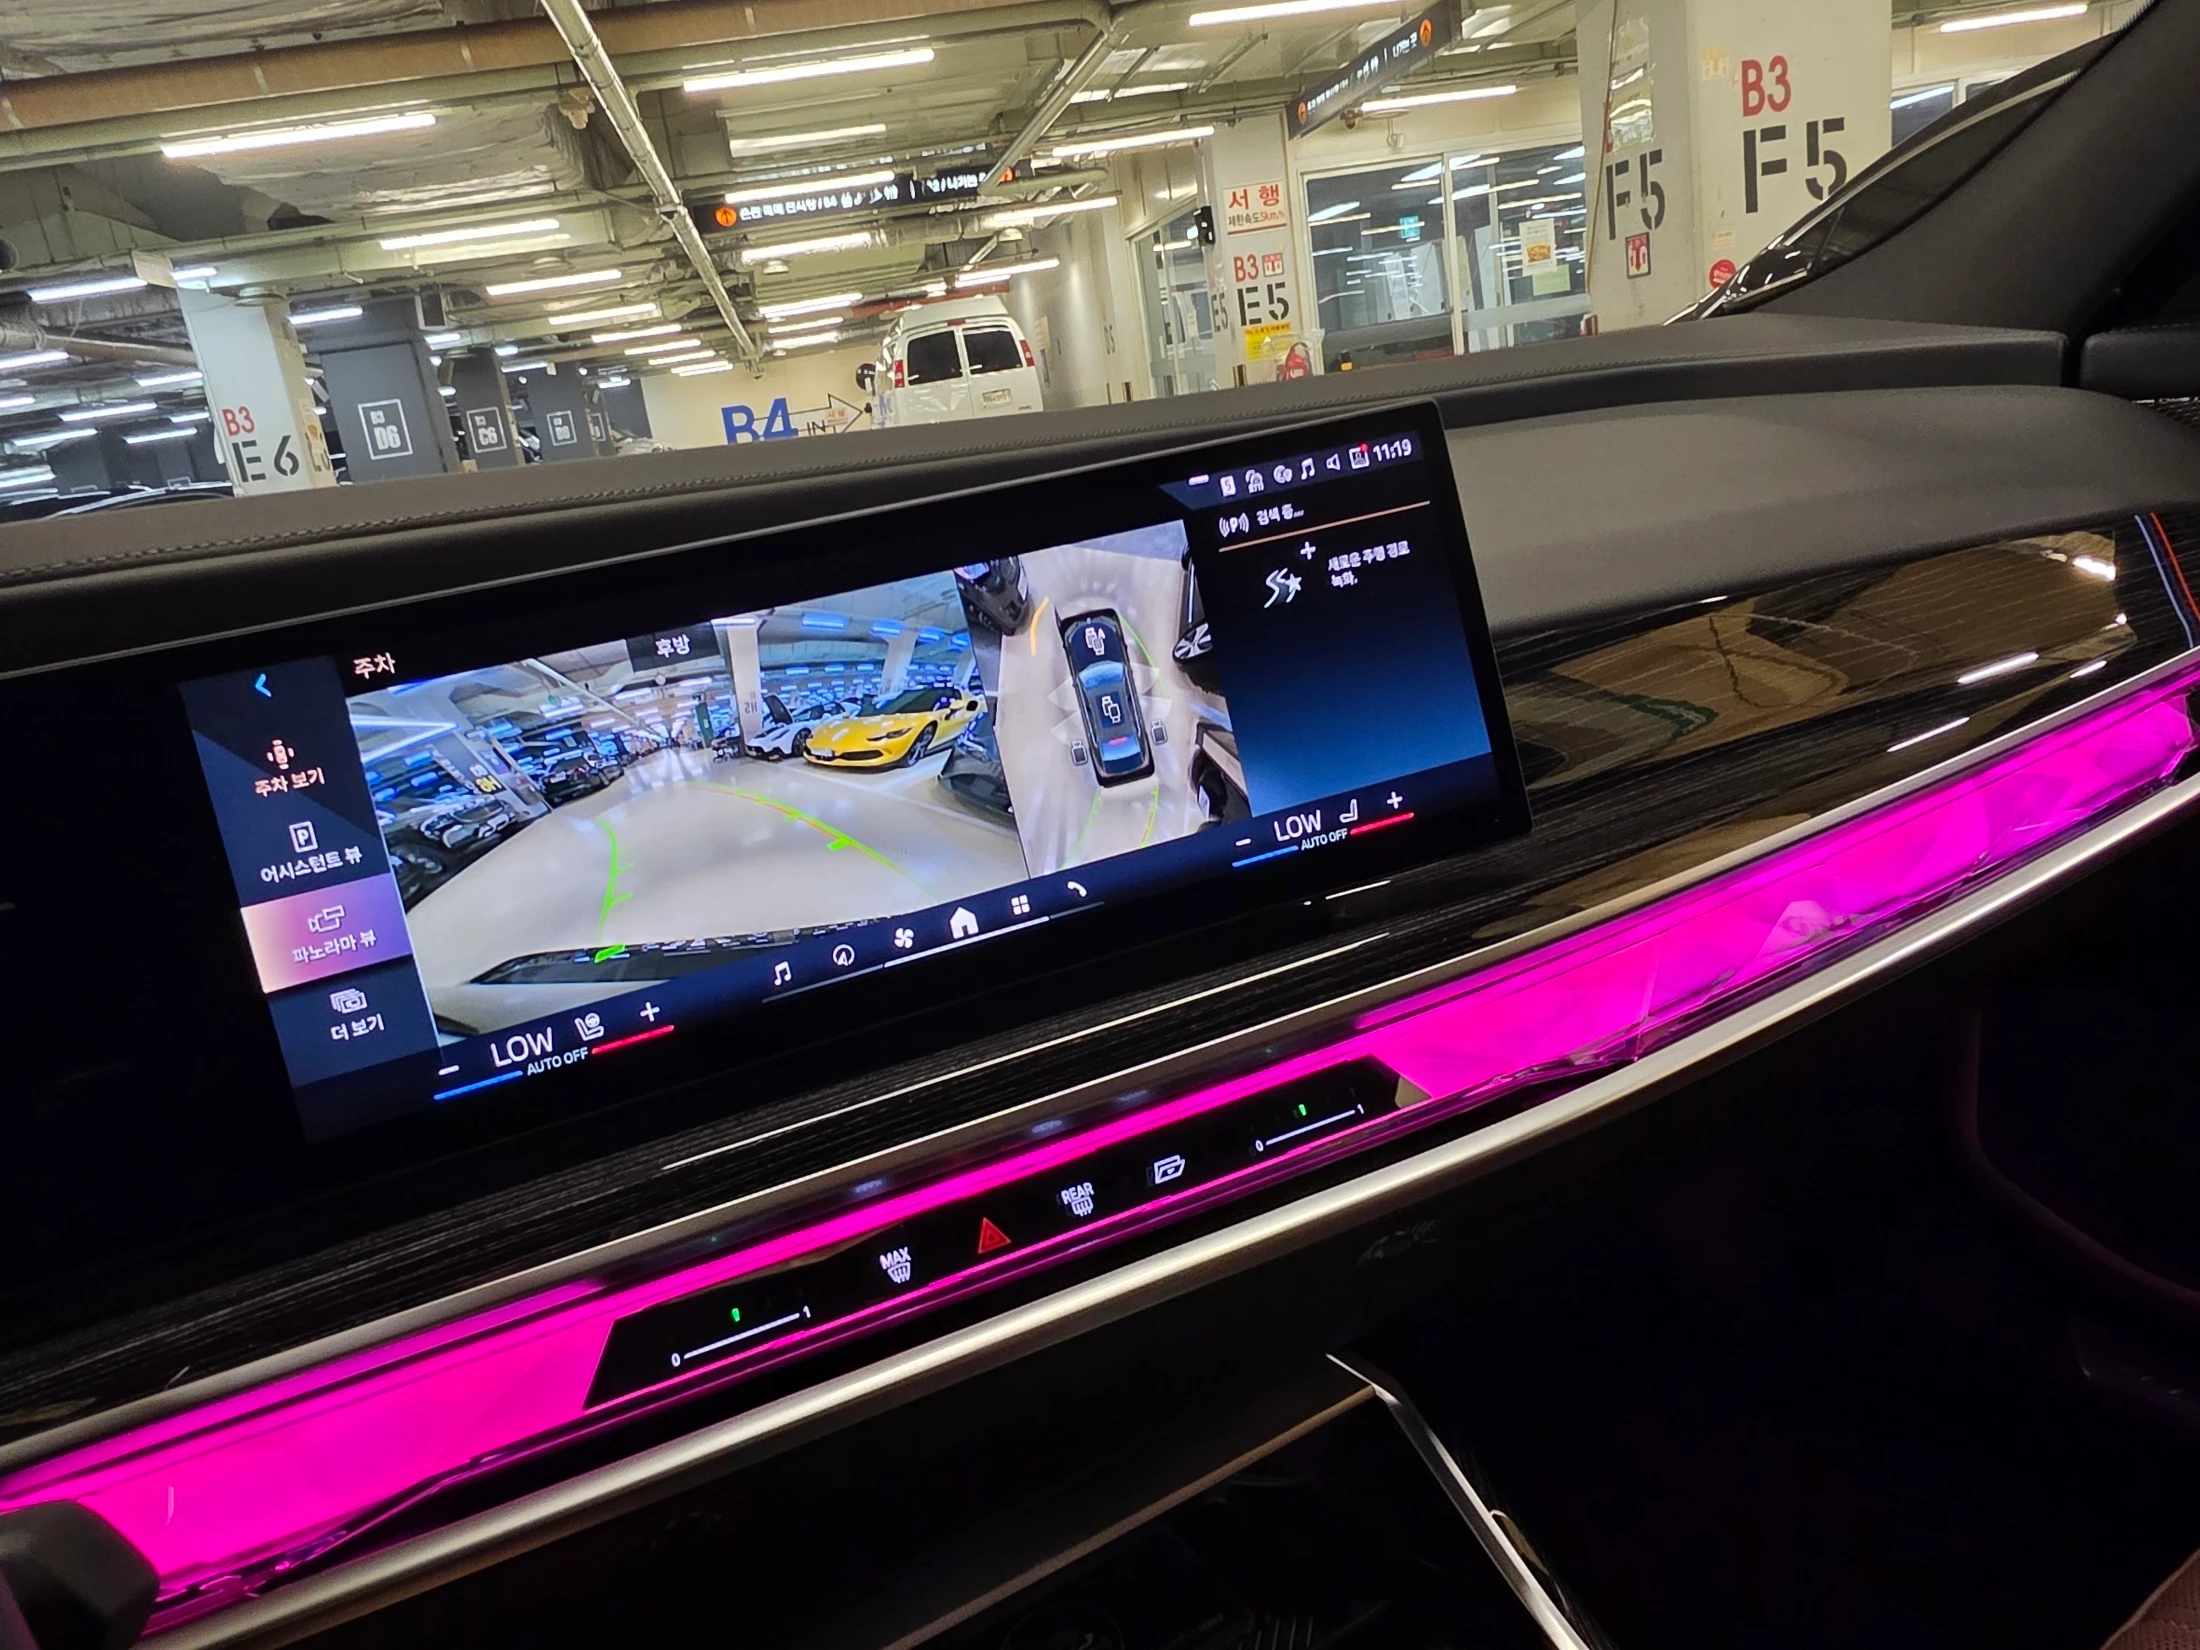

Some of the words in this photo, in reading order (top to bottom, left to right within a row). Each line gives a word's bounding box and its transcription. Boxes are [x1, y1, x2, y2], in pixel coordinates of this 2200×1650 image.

[1741, 55, 1791, 117] B3
[1743, 117, 1847, 214] F5
[1606, 149, 1665, 240] F5
[1233, 253, 1260, 283] B3
[1211, 292, 1228, 332] E5
[1237, 282, 1290, 327] E5
[222, 405, 255, 437] B3
[721, 396, 799, 446] B4
[373, 424, 401, 450] D6
[1372, 438, 1413, 463] 11:19
[231, 434, 300, 483] E6
[655, 633, 690, 658] 후방
[352, 652, 396, 680] 주차
[254, 775, 289, 798] 주차
[291, 766, 326, 790] 보기
[1273, 809, 1322, 842] LOW
[1301, 834, 1328, 851] AUTO
[1328, 827, 1349, 843] OFF
[260, 850, 344, 884] 어시스턴트
[344, 845, 363, 866] 뷰
[291, 934, 357, 964] 파노라마
[359, 929, 377, 948] 뷰
[330, 1023, 350, 1041] 더
[351, 1012, 385, 1037] 보기
[490, 1026, 554, 1068] LOW
[526, 1054, 563, 1077] AUTO
[563, 1046, 589, 1065] OFF
[1254, 1139, 1264, 1153] 0
[1061, 1182, 1095, 1206] REAR
[879, 1246, 912, 1270] MAX
[802, 1305, 811, 1319] 1
[670, 1353, 681, 1368] 0
